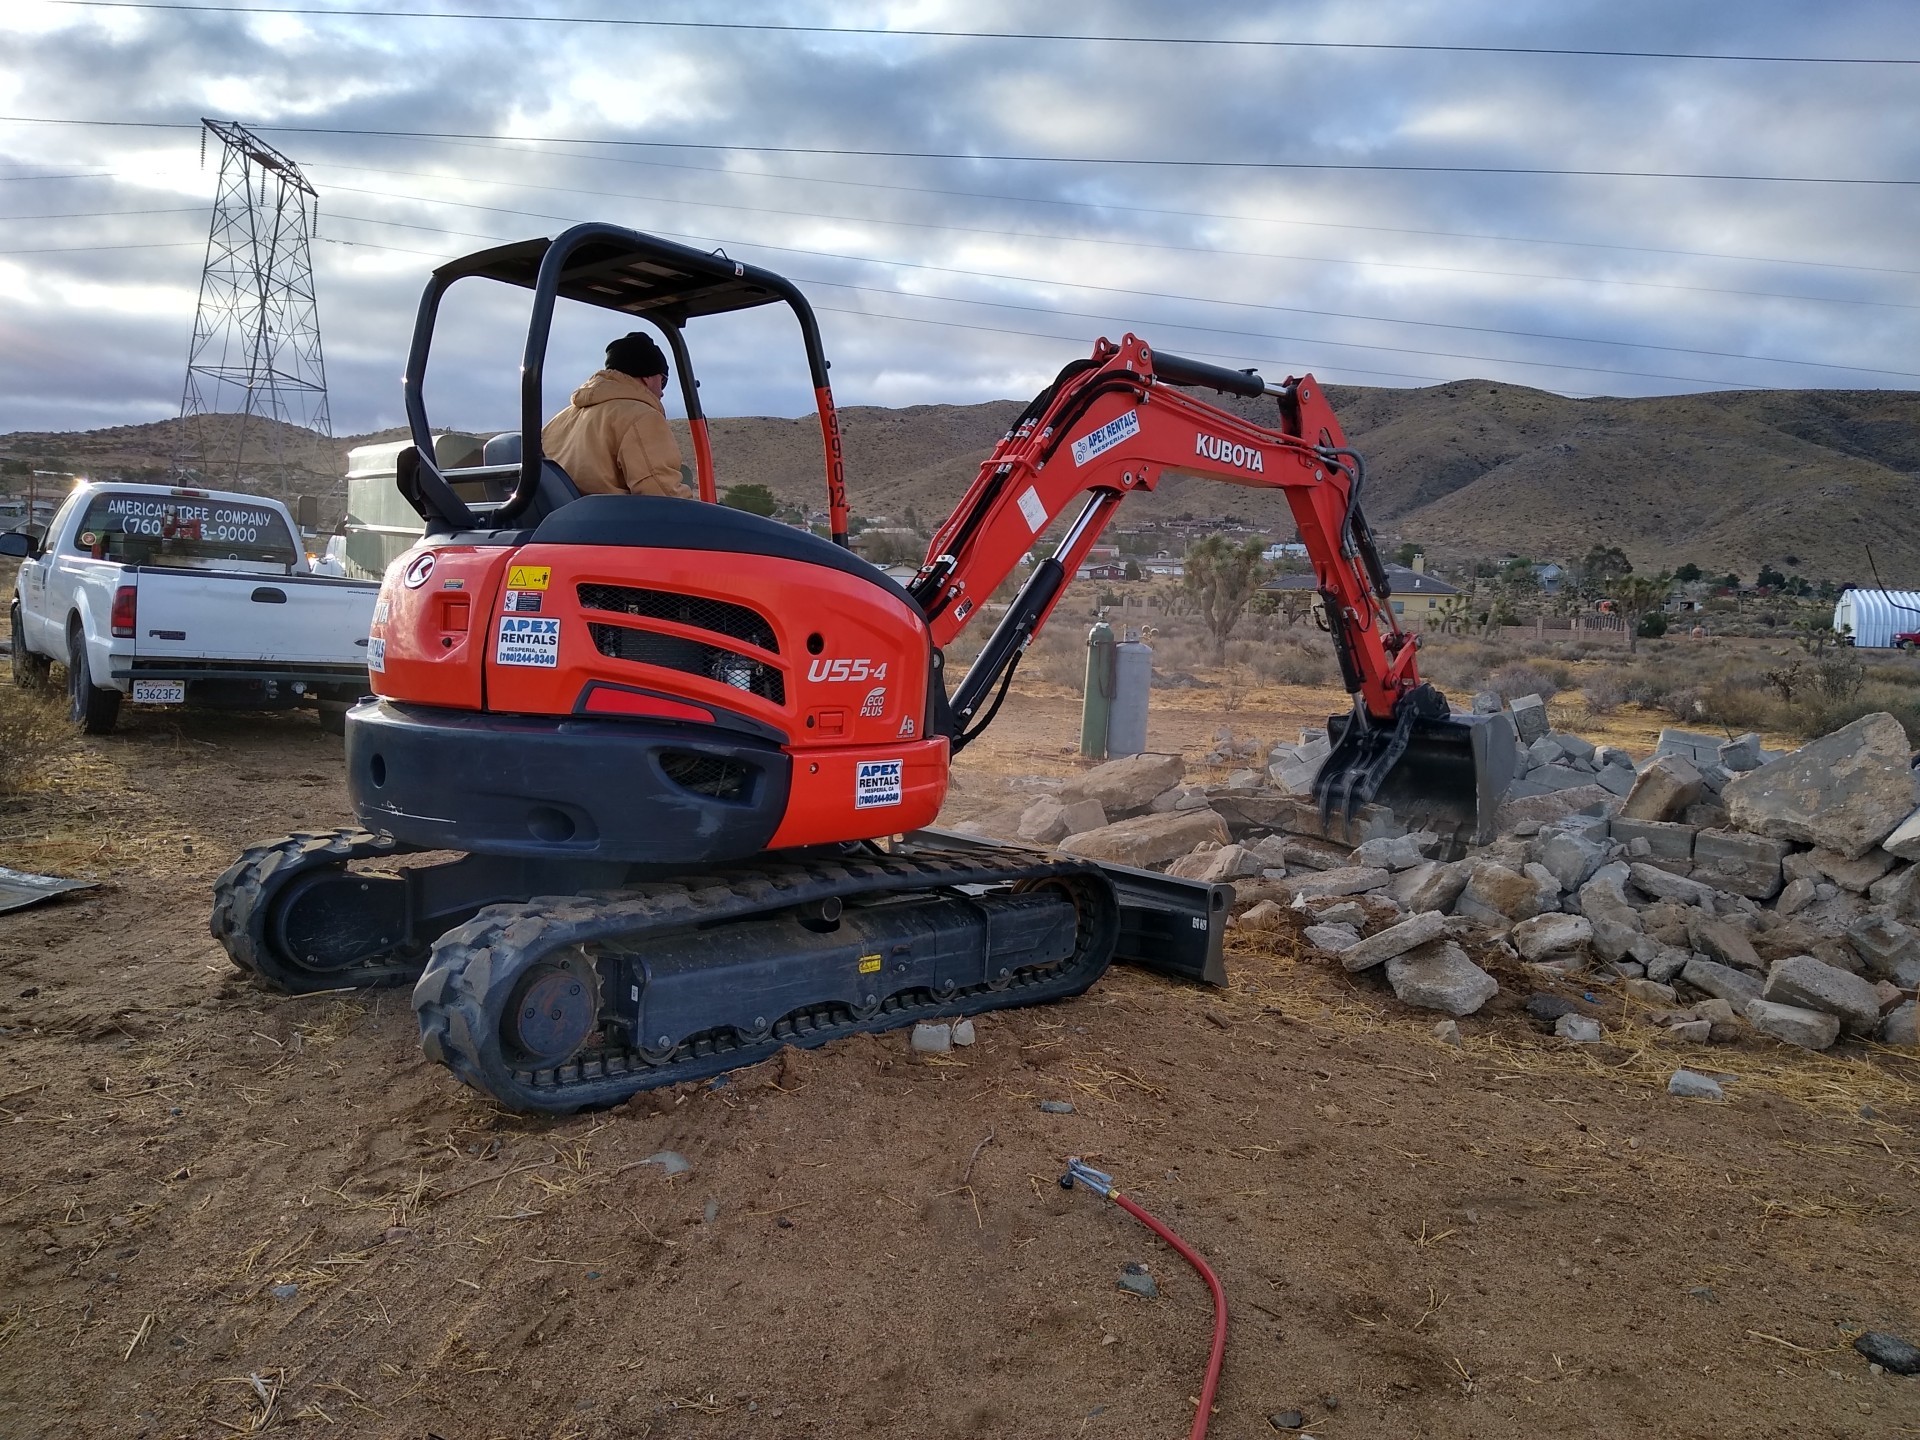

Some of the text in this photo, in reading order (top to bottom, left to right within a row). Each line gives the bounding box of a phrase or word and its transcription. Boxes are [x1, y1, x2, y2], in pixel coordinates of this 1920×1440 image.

[1088, 411, 1137, 449] APEX RENTALS
[1092, 427, 1136, 455] HESPERIA, CA
[1195, 432, 1264, 473] KUBOTA
[177, 505, 210, 521] TREE
[215, 509, 271, 527] COMPANY
[502, 619, 558, 634] APEX
[500, 633, 557, 645] RENTALS
[500, 652, 555, 665] (760)244-9349
[807, 659, 888, 682] U55-4
[136, 688, 181, 700] 53623F2
[867, 696, 884, 706] eco
[860, 706, 883, 717] PLUS
[860, 763, 899, 777] APEX
[859, 776, 900, 788] RENTALS
